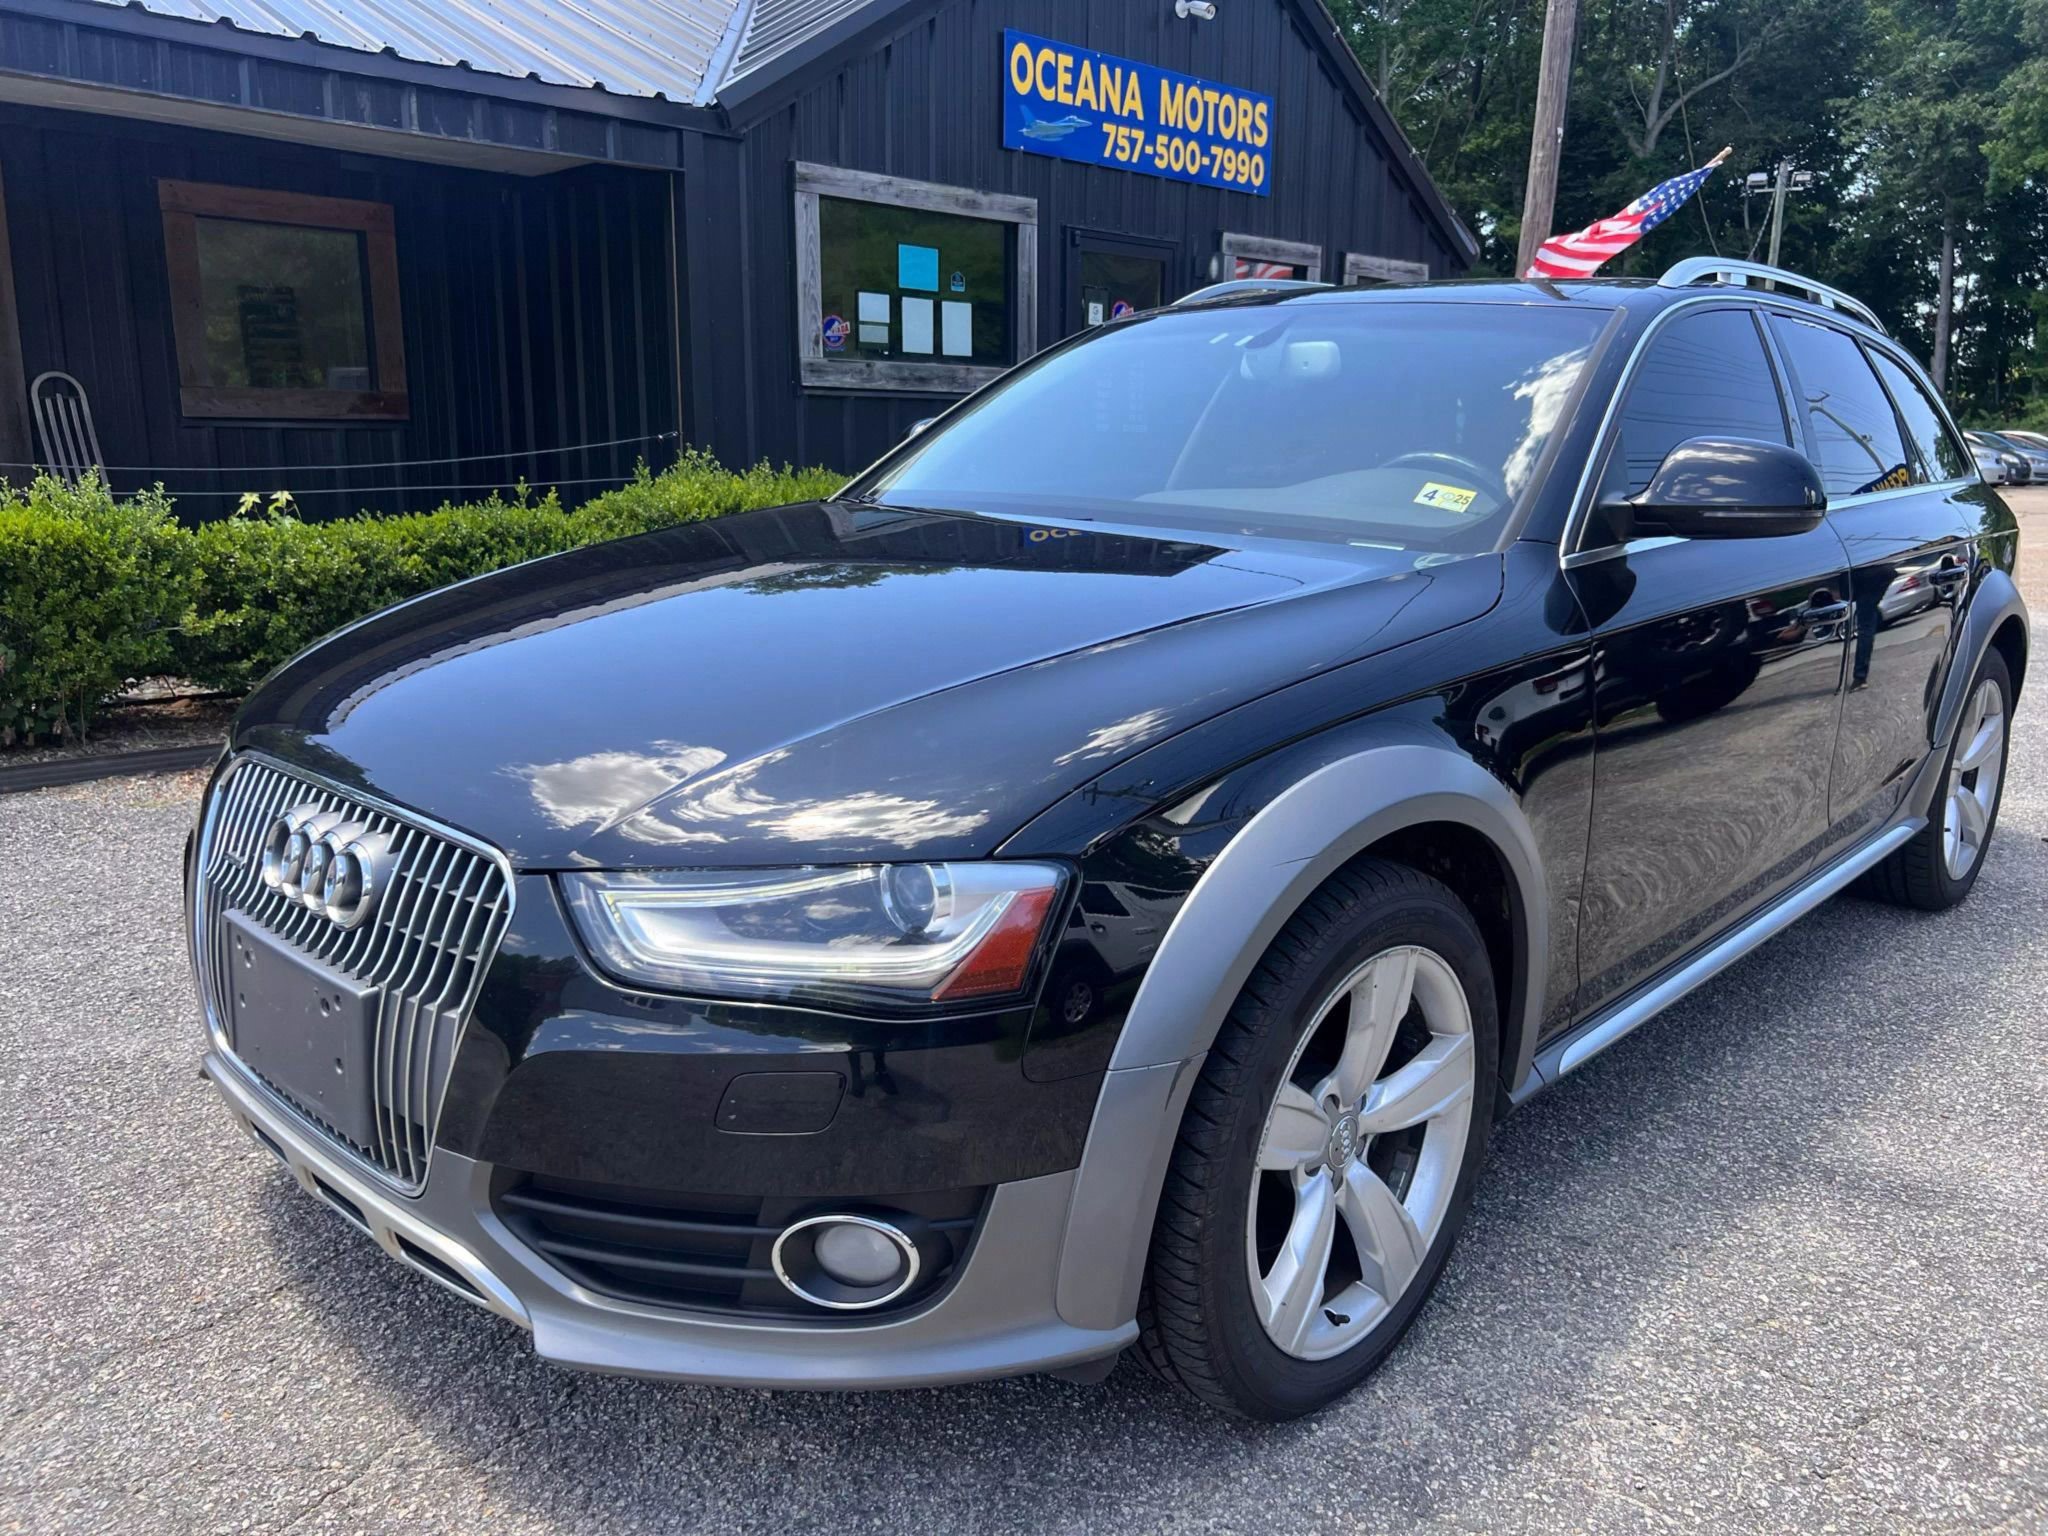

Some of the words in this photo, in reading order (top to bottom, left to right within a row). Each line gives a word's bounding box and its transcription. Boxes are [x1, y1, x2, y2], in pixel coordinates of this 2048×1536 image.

[1010, 42, 1144, 120] OCEANA
[1160, 79, 1268, 147] MOTORS
[1102, 123, 1264, 187] 757-500-7990
[1424, 490, 1438, 501] 4
[1454, 494, 1471, 505] 25
